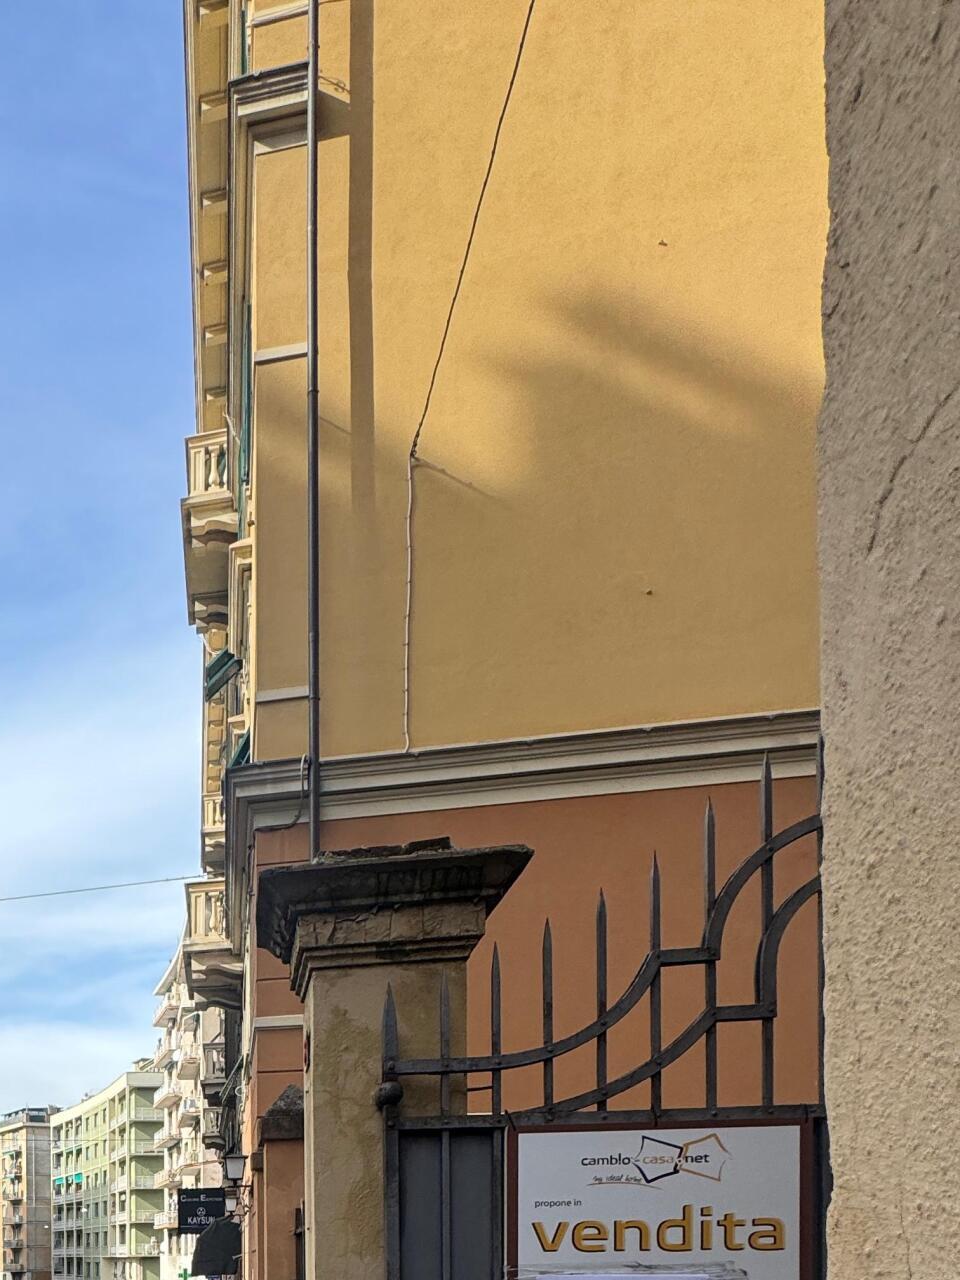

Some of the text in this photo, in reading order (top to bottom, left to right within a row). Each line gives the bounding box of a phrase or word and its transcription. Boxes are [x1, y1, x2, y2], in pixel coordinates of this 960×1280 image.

[534, 1199, 582, 1208] propone in
[531, 1203, 786, 1253] vendita
